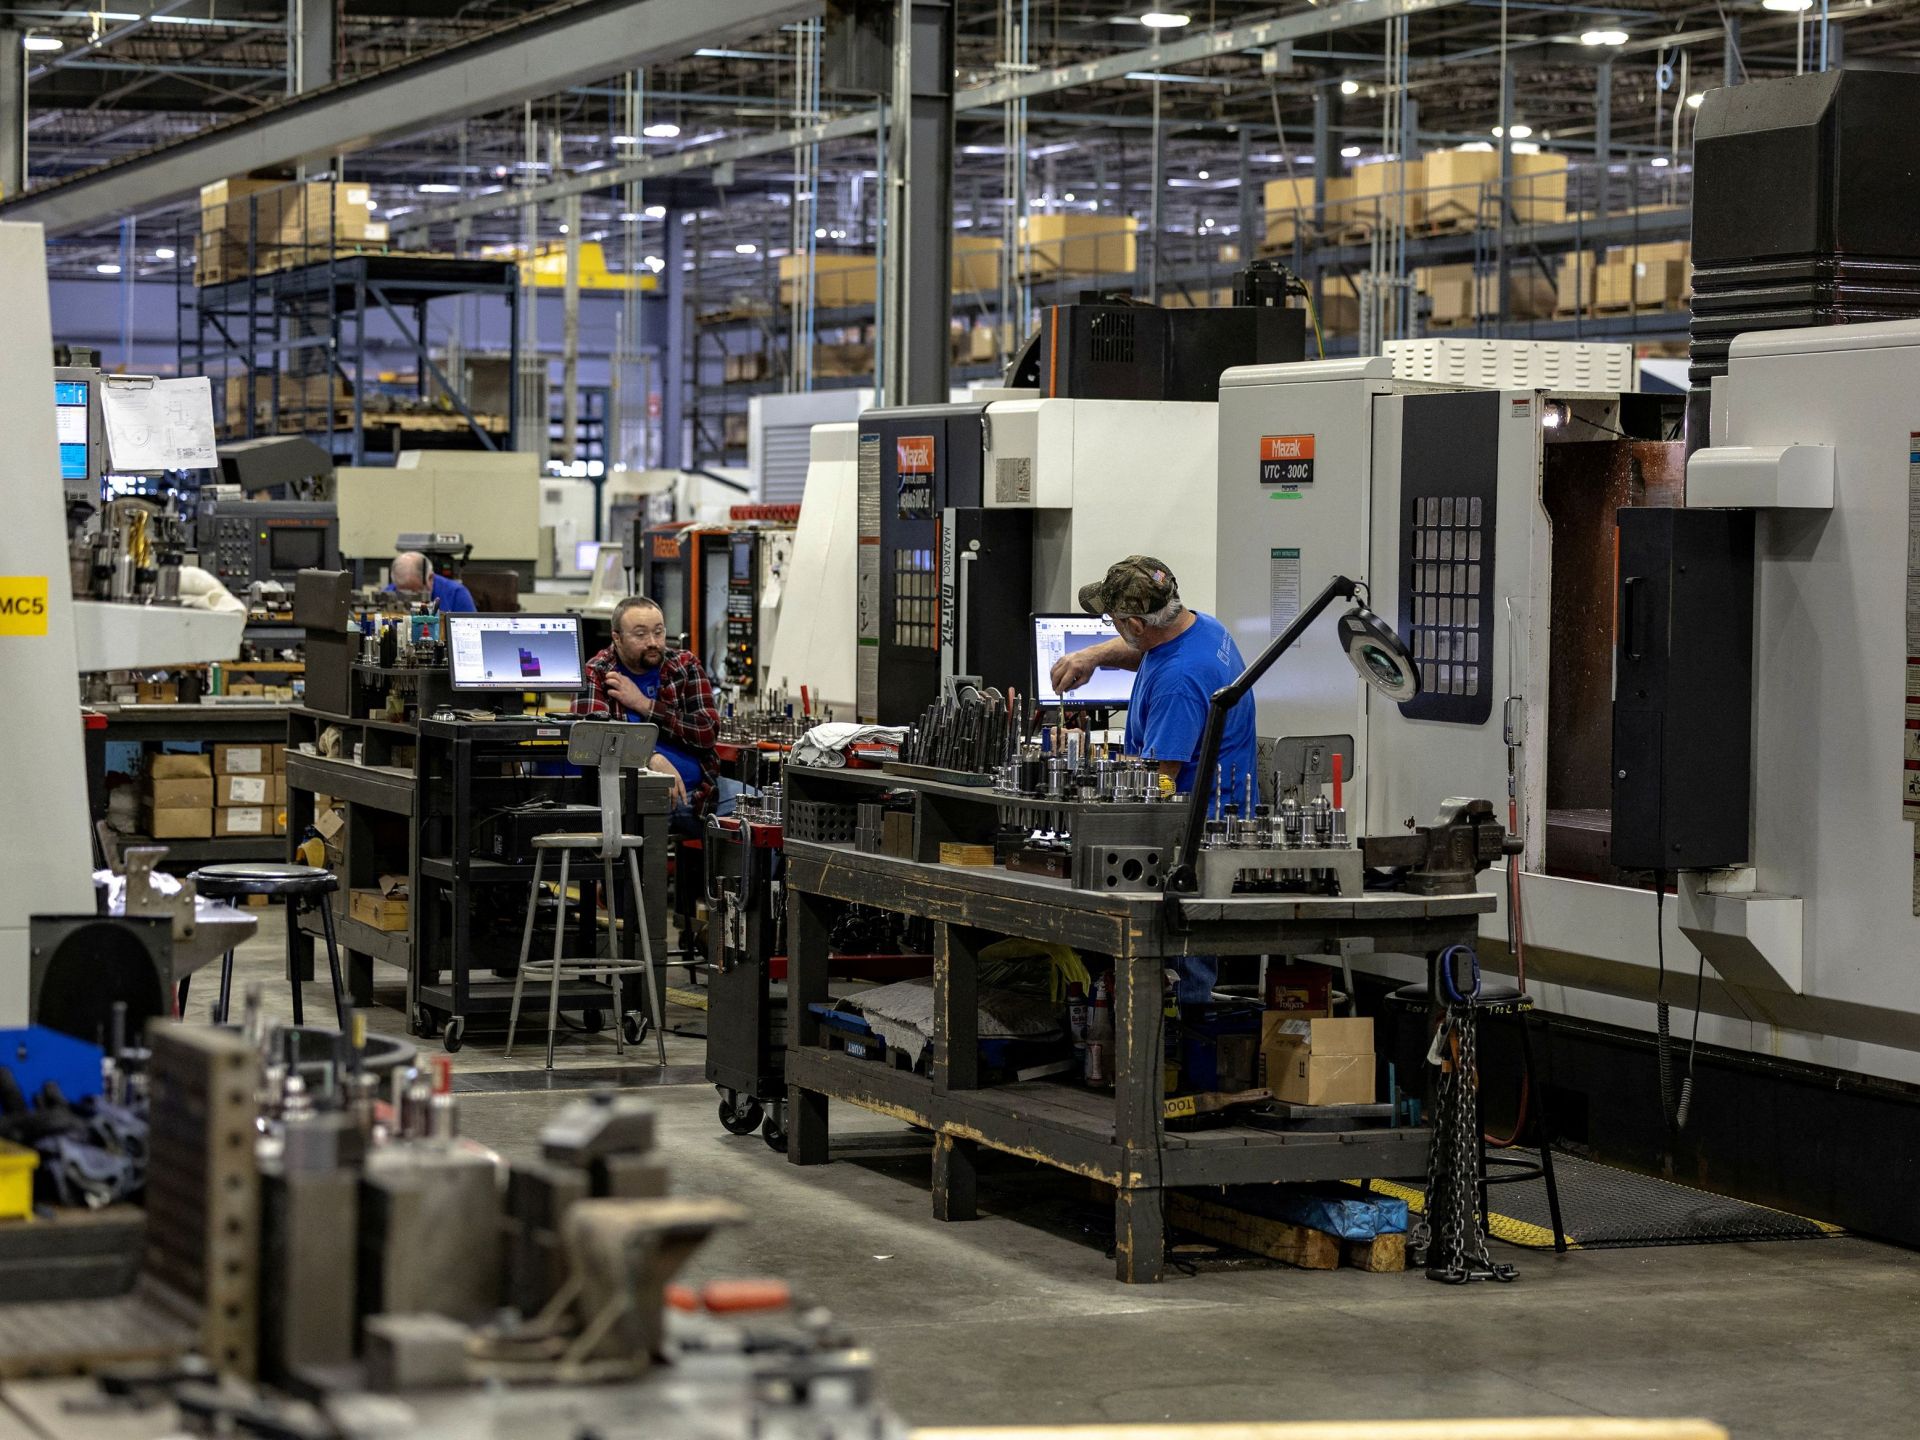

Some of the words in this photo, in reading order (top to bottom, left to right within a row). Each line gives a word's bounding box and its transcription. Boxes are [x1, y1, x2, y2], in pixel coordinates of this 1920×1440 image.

[1271, 439, 1301, 458] Mazak
[1264, 464, 1280, 479] VTC
[1287, 463, 1309, 479] 300C
[943, 526, 951, 577] MAZATROL
